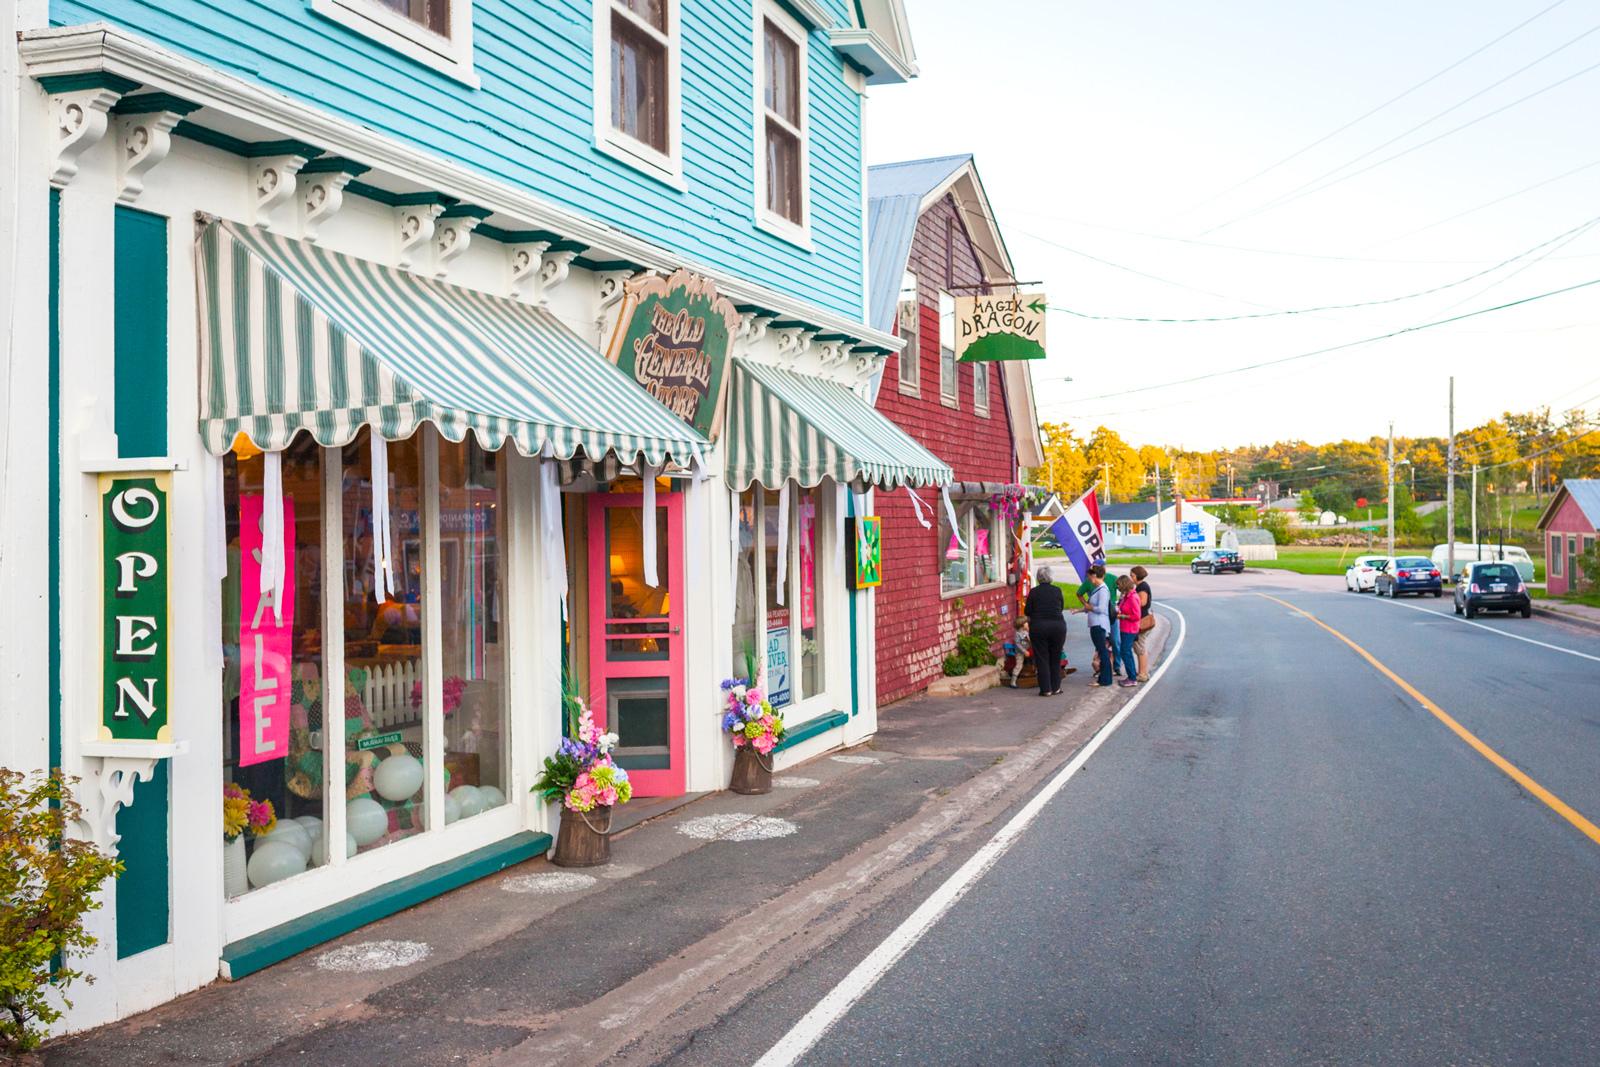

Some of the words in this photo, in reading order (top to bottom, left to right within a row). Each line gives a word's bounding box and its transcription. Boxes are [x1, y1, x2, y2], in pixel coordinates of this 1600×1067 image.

[652, 301, 676, 336] THE
[672, 308, 705, 345] OLD
[962, 311, 1040, 337] DRAGON
[973, 300, 1024, 314] MAGIK
[634, 333, 711, 388] GENERAL
[1077, 520, 1105, 561] OPE
[111, 487, 159, 720] OPEN
[251, 512, 285, 754] ALE
[767, 650, 787, 668] IVER
